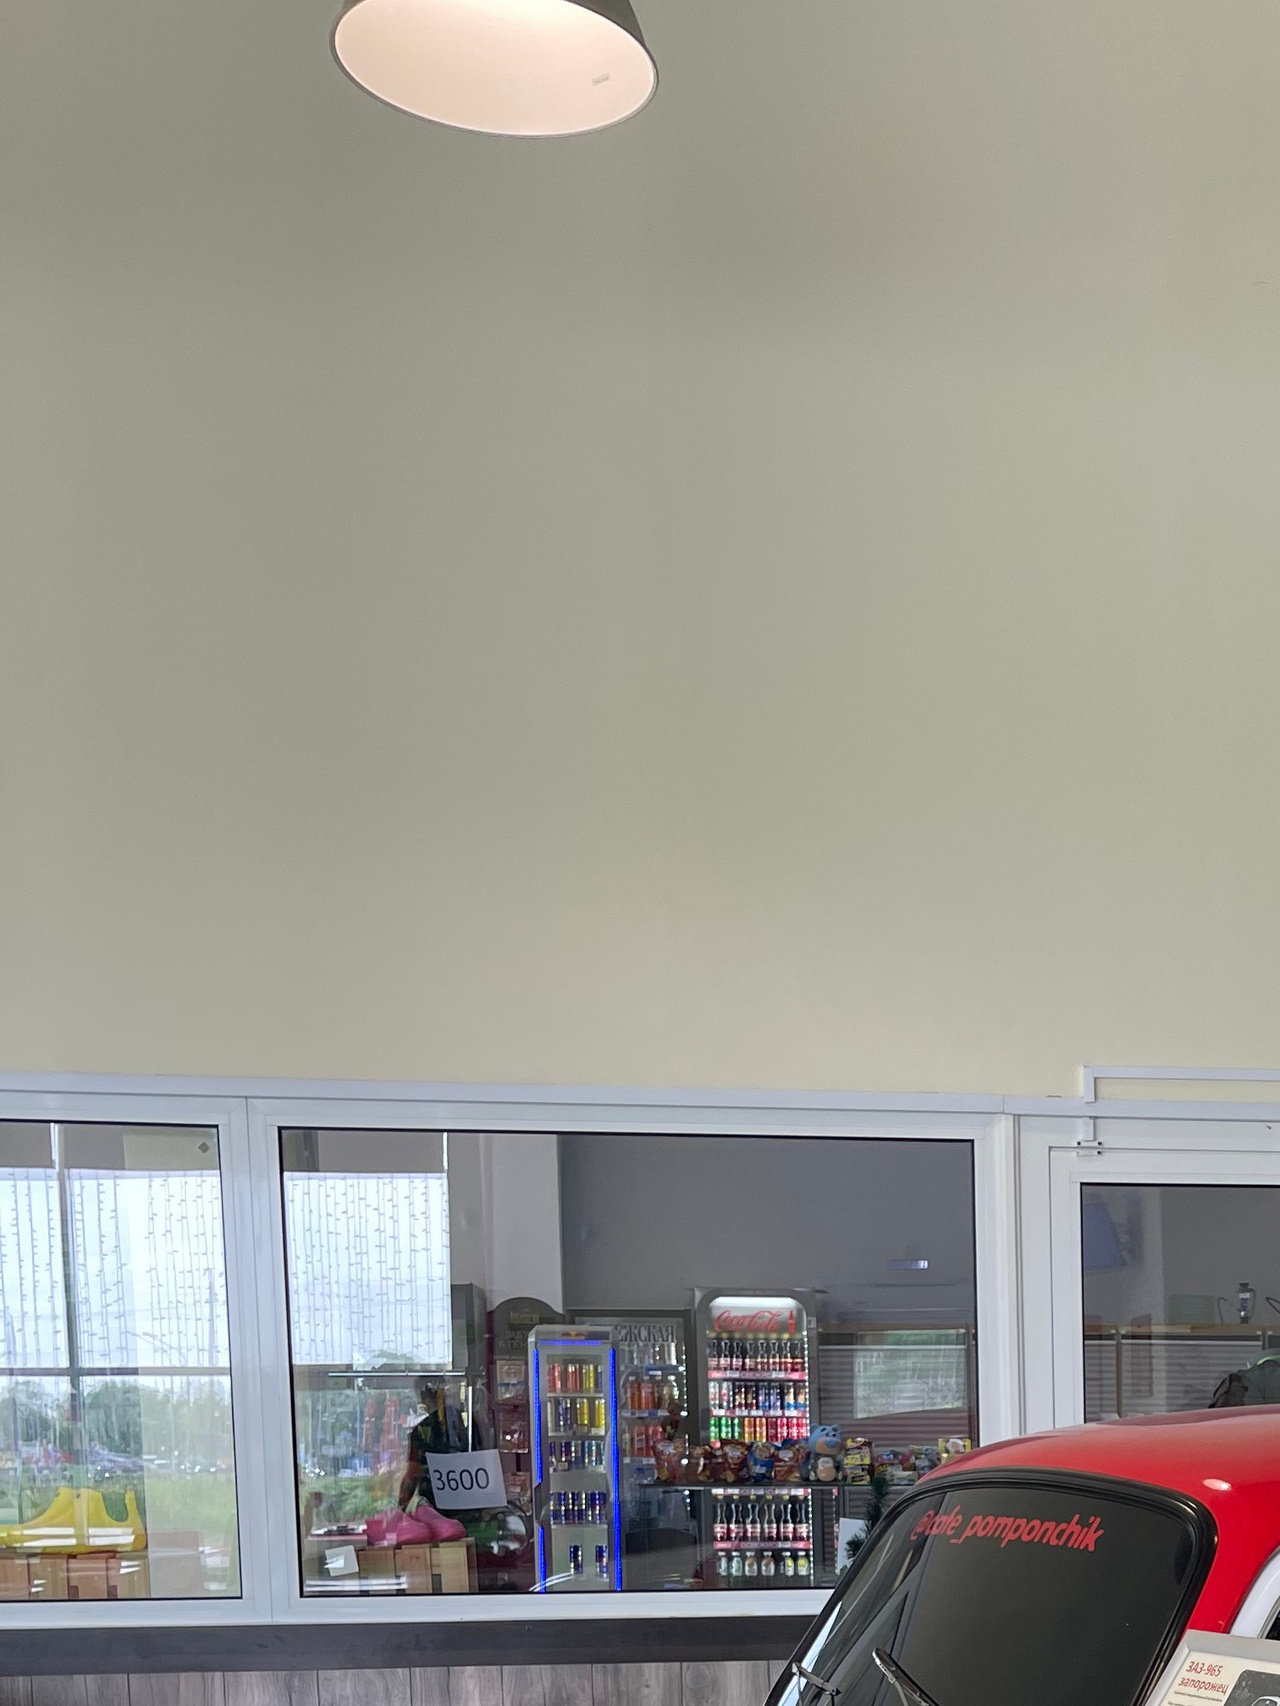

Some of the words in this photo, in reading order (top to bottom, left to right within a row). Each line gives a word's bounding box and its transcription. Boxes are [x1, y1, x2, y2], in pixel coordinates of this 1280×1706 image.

[433, 1467, 490, 1492] 3600
[1186, 1661, 1223, 1677] ЗАЗ-965
[1178, 1677, 1229, 1696] запорожец
